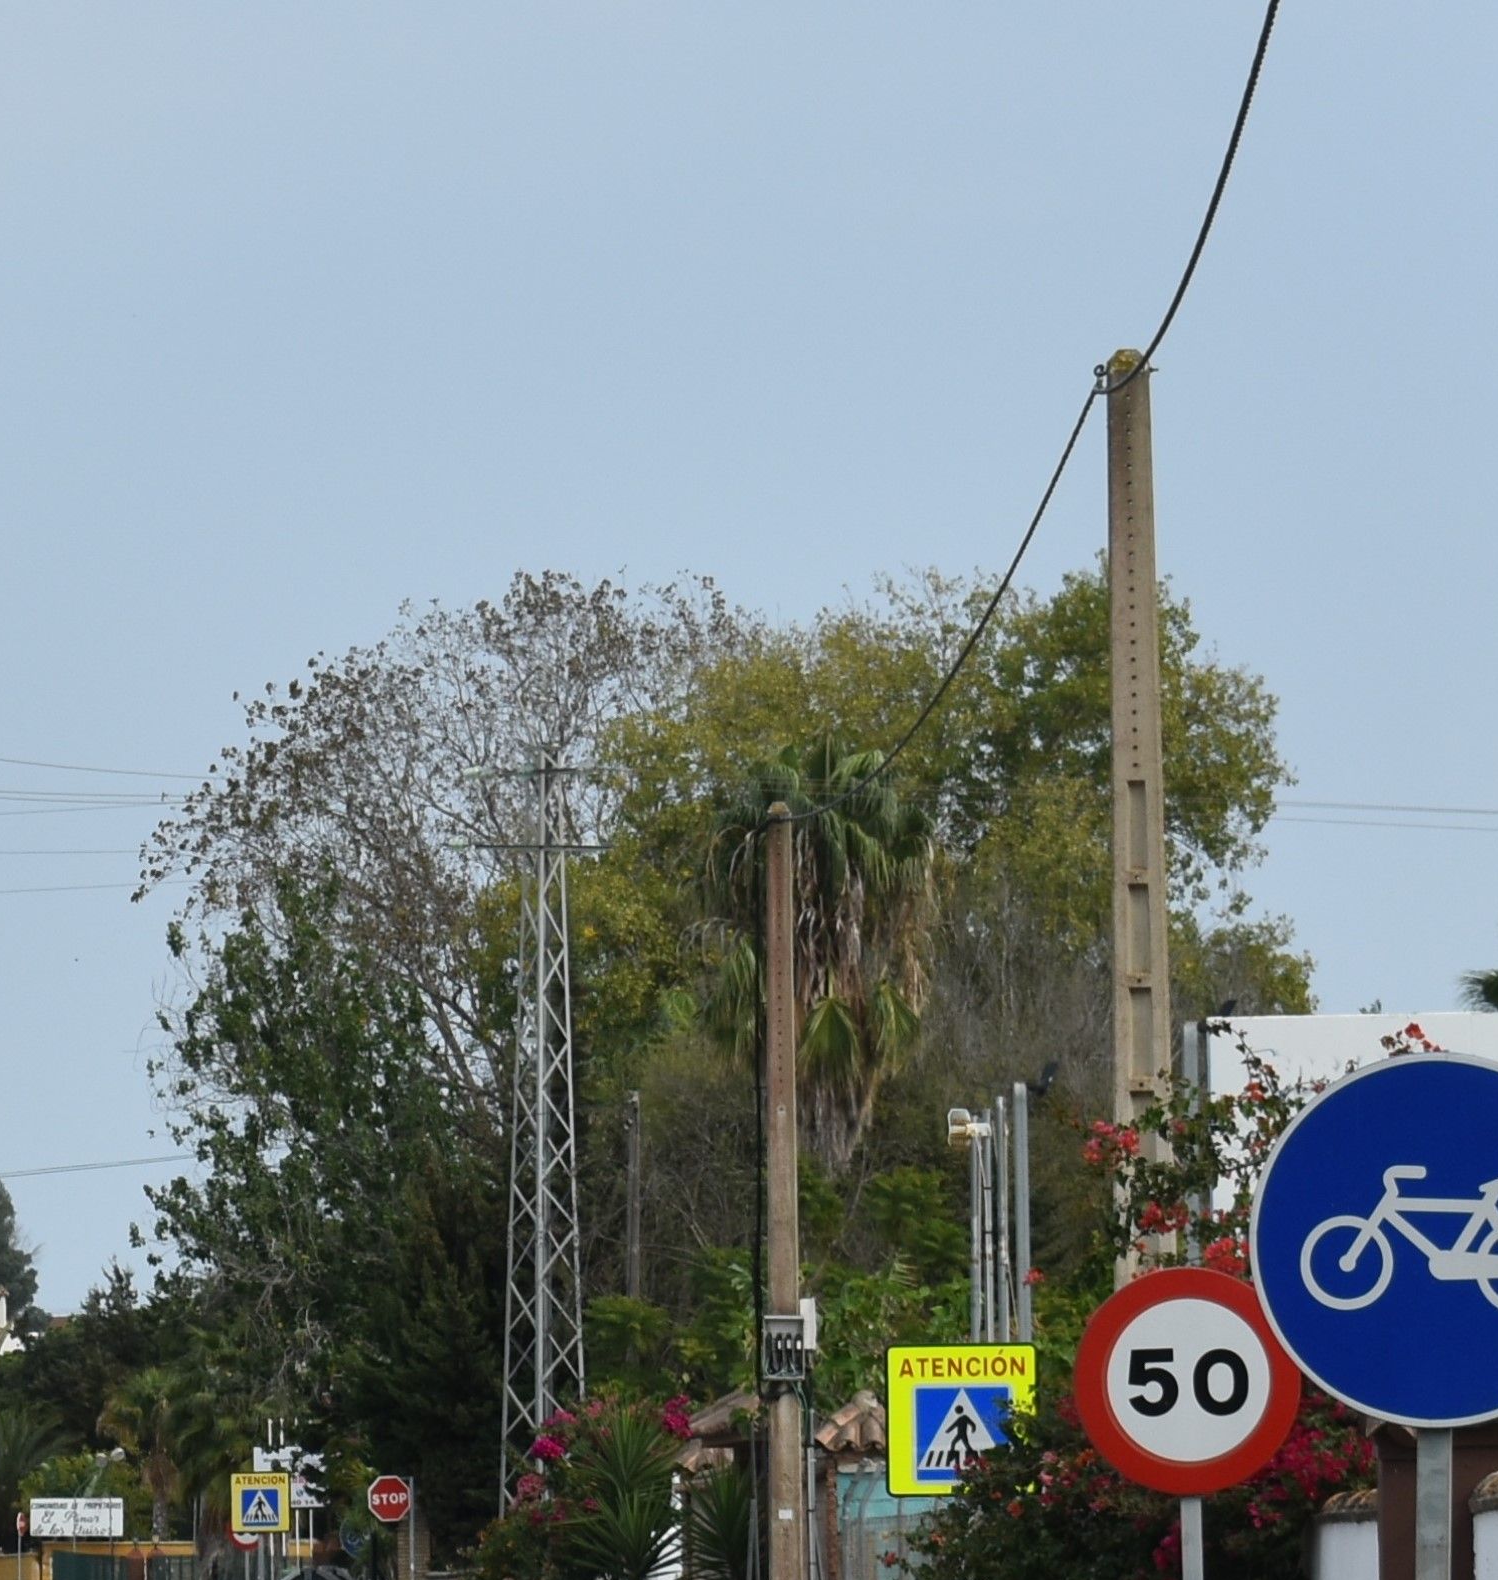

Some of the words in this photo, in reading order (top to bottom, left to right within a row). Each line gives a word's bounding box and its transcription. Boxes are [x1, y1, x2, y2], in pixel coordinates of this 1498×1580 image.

[899, 1349, 1026, 1378] ATENCIÓN
[1128, 1347, 1249, 1417] 50
[372, 1492, 407, 1506] STOP
